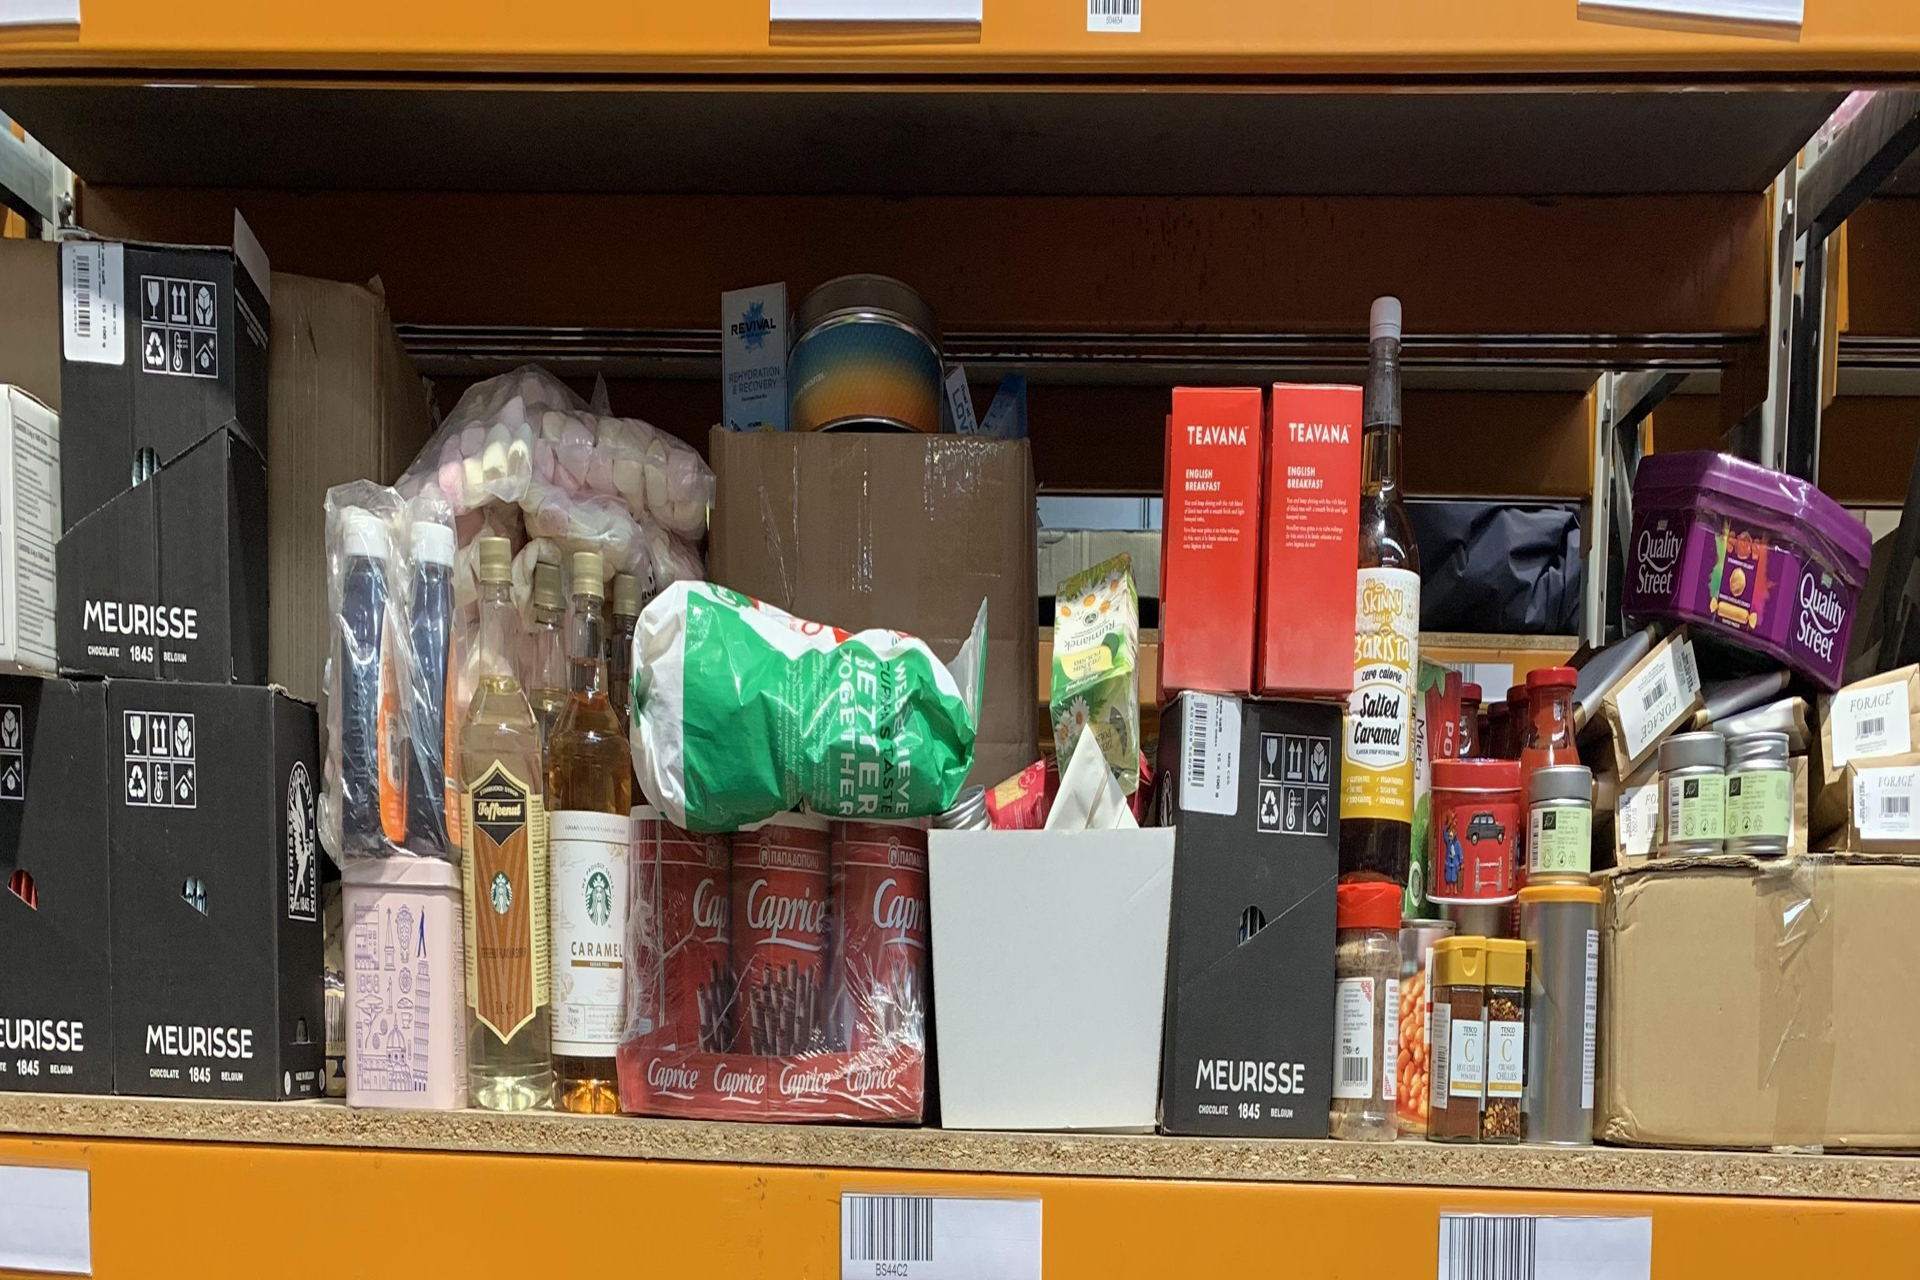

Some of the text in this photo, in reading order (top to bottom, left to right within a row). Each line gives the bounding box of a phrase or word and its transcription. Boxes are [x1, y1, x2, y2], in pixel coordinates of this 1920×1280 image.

[730, 318, 776, 336] REVIVAL
[728, 366, 780, 384] REHYDRATION
[732, 378, 778, 396] & RECOVERY
[952, 388, 971, 433] LOV
[1187, 425, 1247, 446] TEAVANA
[1289, 422, 1350, 444] TEAVANA
[1186, 468, 1213, 480] ENGLISH
[1287, 466, 1316, 477] ENGLISH
[1185, 480, 1221, 492] BREAKFAST
[1287, 478, 1324, 490] BREAKFAST
[1638, 530, 1683, 572] Quality
[1636, 564, 1673, 594] Street
[1363, 589, 1403, 616] SKINNY
[1800, 572, 1846, 634] Quality
[83, 600, 198, 640] MEURISSE
[1064, 620, 1116, 650] Rumianek
[1797, 610, 1834, 662] Street
[88, 645, 188, 663] CHOCOLATE 1845 BELGIUM
[1362, 666, 1402, 684] zero calorie
[1360, 690, 1400, 720] Salted
[1850, 692, 1892, 713] FORAGE
[1640, 696, 1677, 738] FORAGE
[839, 648, 856, 816] TOGETHER
[854, 656, 880, 814] BETTER
[1354, 720, 1400, 746] Caramel
[881, 746, 894, 814] TASTE
[1878, 775, 1914, 788] FORAGE
[478, 802, 522, 821] Toffeenut
[586, 861, 605, 877] PROUDLY
[748, 878, 825, 938] Caprice
[570, 942, 623, 958] CARAMEL
[356, 972, 380, 994] 1858
[146, 1024, 254, 1059] MEURISSE
[16, 1060, 40, 1076] 1845
[50, 1064, 74, 1076] BELGIUM
[150, 1067, 244, 1084] CHOCOLATE 1845 BELGIUM
[648, 1058, 698, 1092] Caprice
[779, 1062, 831, 1095] Caprice
[1196, 1058, 1306, 1094] MEURISSE
[1456, 1064, 1466, 1072] HOT
[1496, 1072, 1517, 1080] CHILLIES
[713, 1063, 766, 1096] Caprice
[1198, 1103, 1294, 1120] CHOCOLATE 1845 BELGIUM
[876, 1263, 908, 1277] BS44C2
